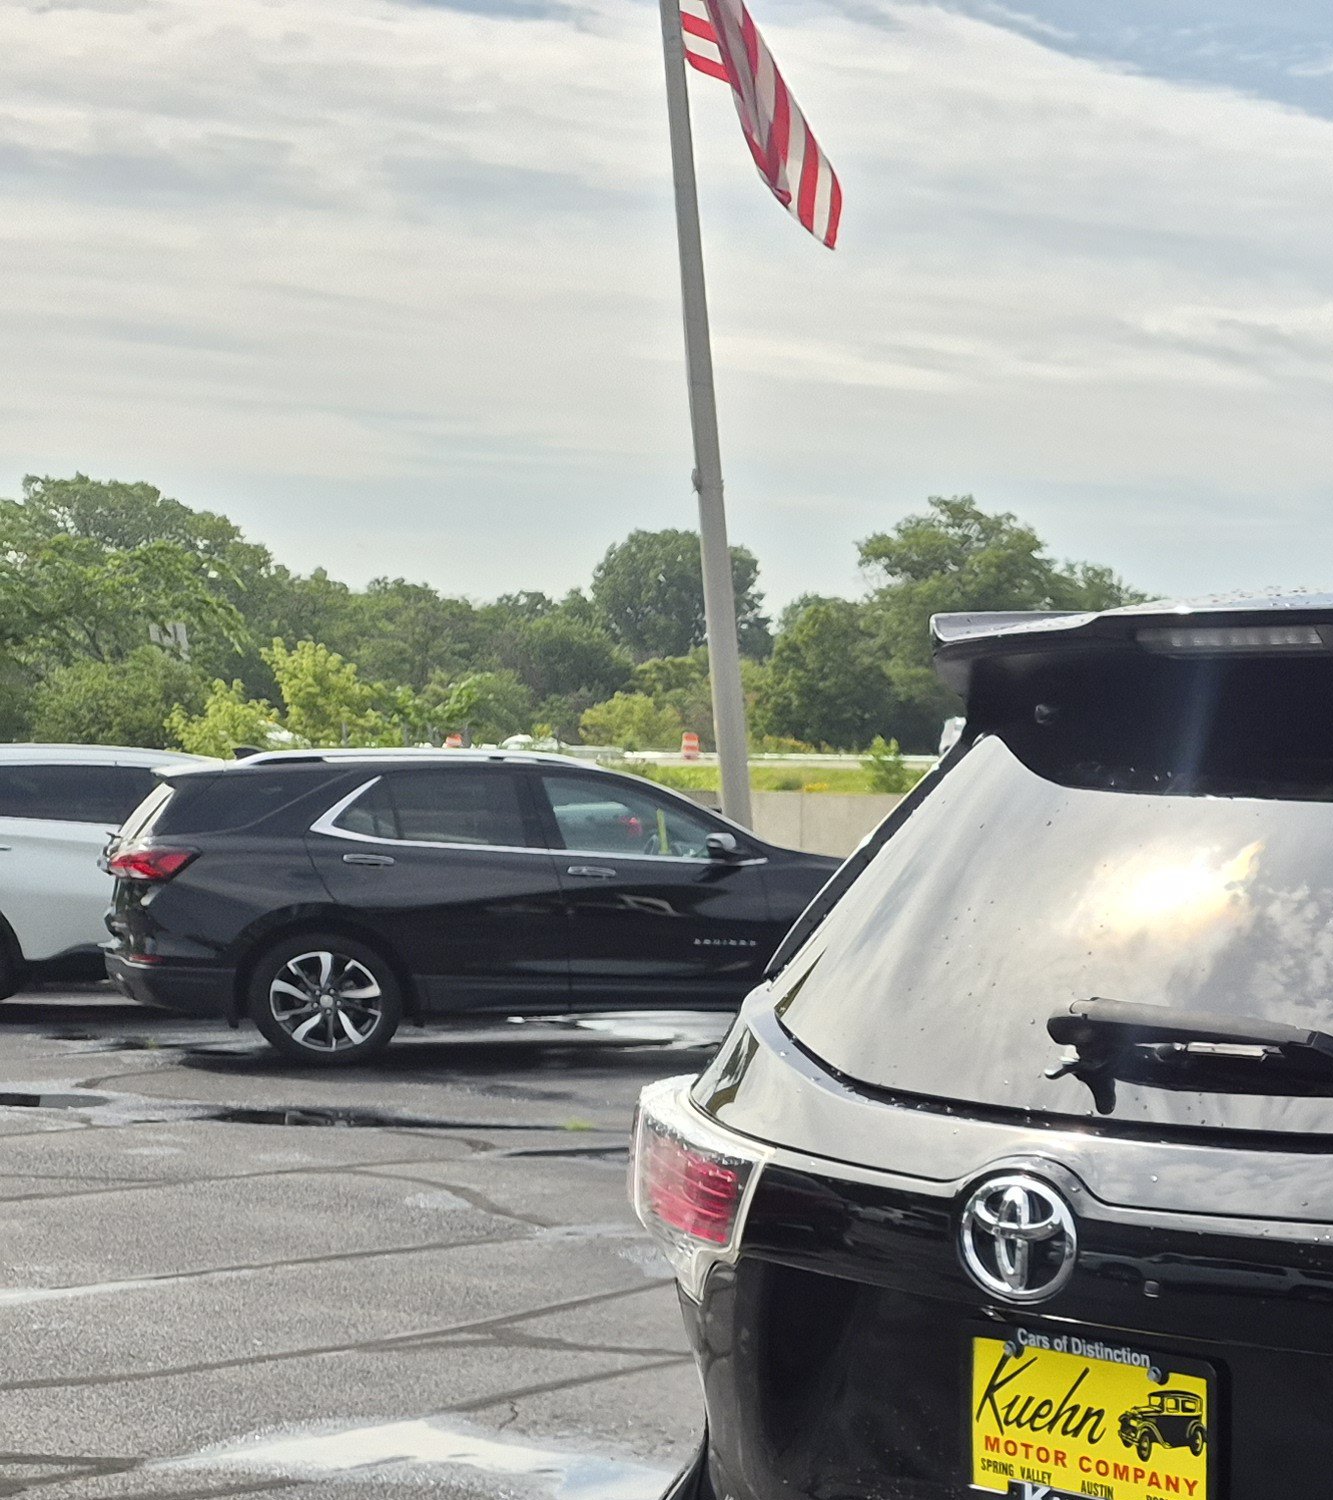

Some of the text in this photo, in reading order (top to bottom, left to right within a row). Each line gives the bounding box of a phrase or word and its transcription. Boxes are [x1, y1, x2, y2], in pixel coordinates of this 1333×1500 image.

[1017, 1328, 1150, 1367] Cars of Distinction
[976, 1353, 1106, 1444] Kuehn
[981, 1457, 1052, 1486] SPRING VALLEY
[985, 1435, 1198, 1496] MOTOR COMPANY
[1081, 1480, 1114, 1500] AUSTIN
